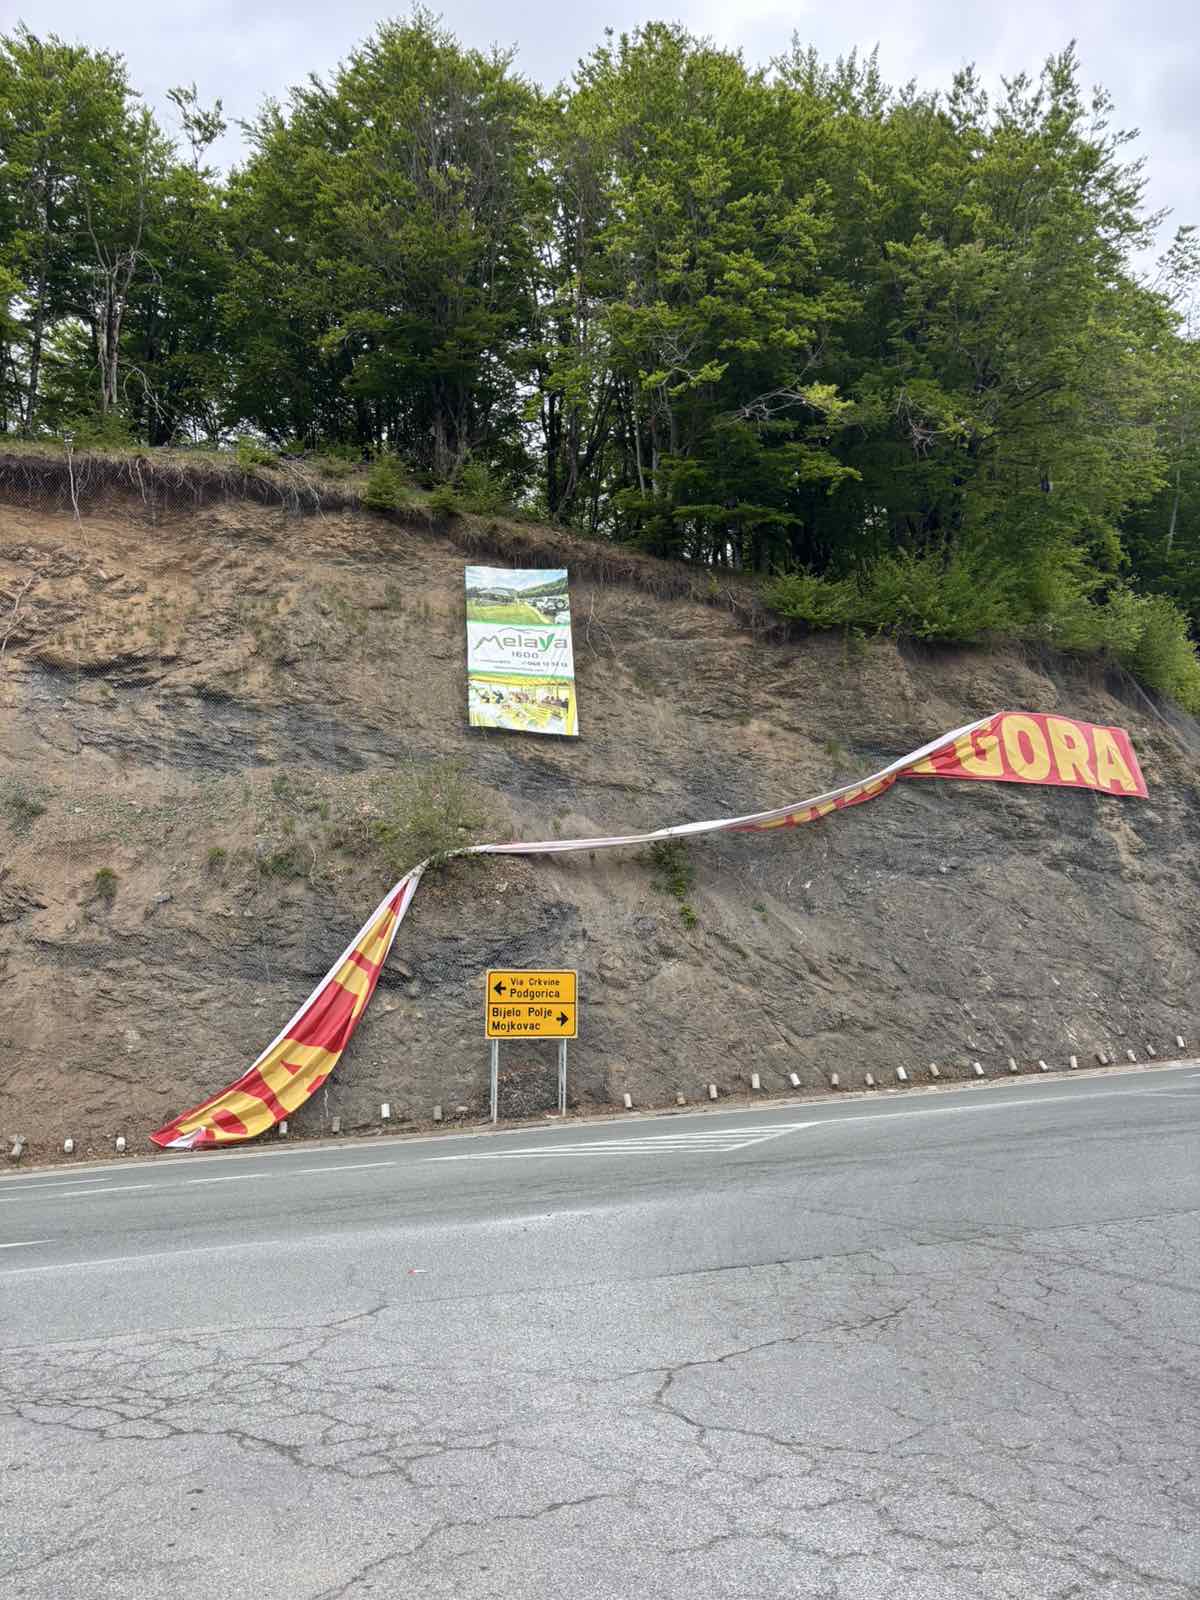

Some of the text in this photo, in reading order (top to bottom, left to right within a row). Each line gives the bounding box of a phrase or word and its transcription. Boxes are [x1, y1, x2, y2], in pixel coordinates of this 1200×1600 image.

[955, 714, 1139, 792] GORA
[510, 977, 560, 986] Via Crkvine
[510, 988, 560, 1000] Podgorica
[492, 1007, 553, 1019] Bijelo Polje
[491, 1021, 541, 1033] Mojkovac
